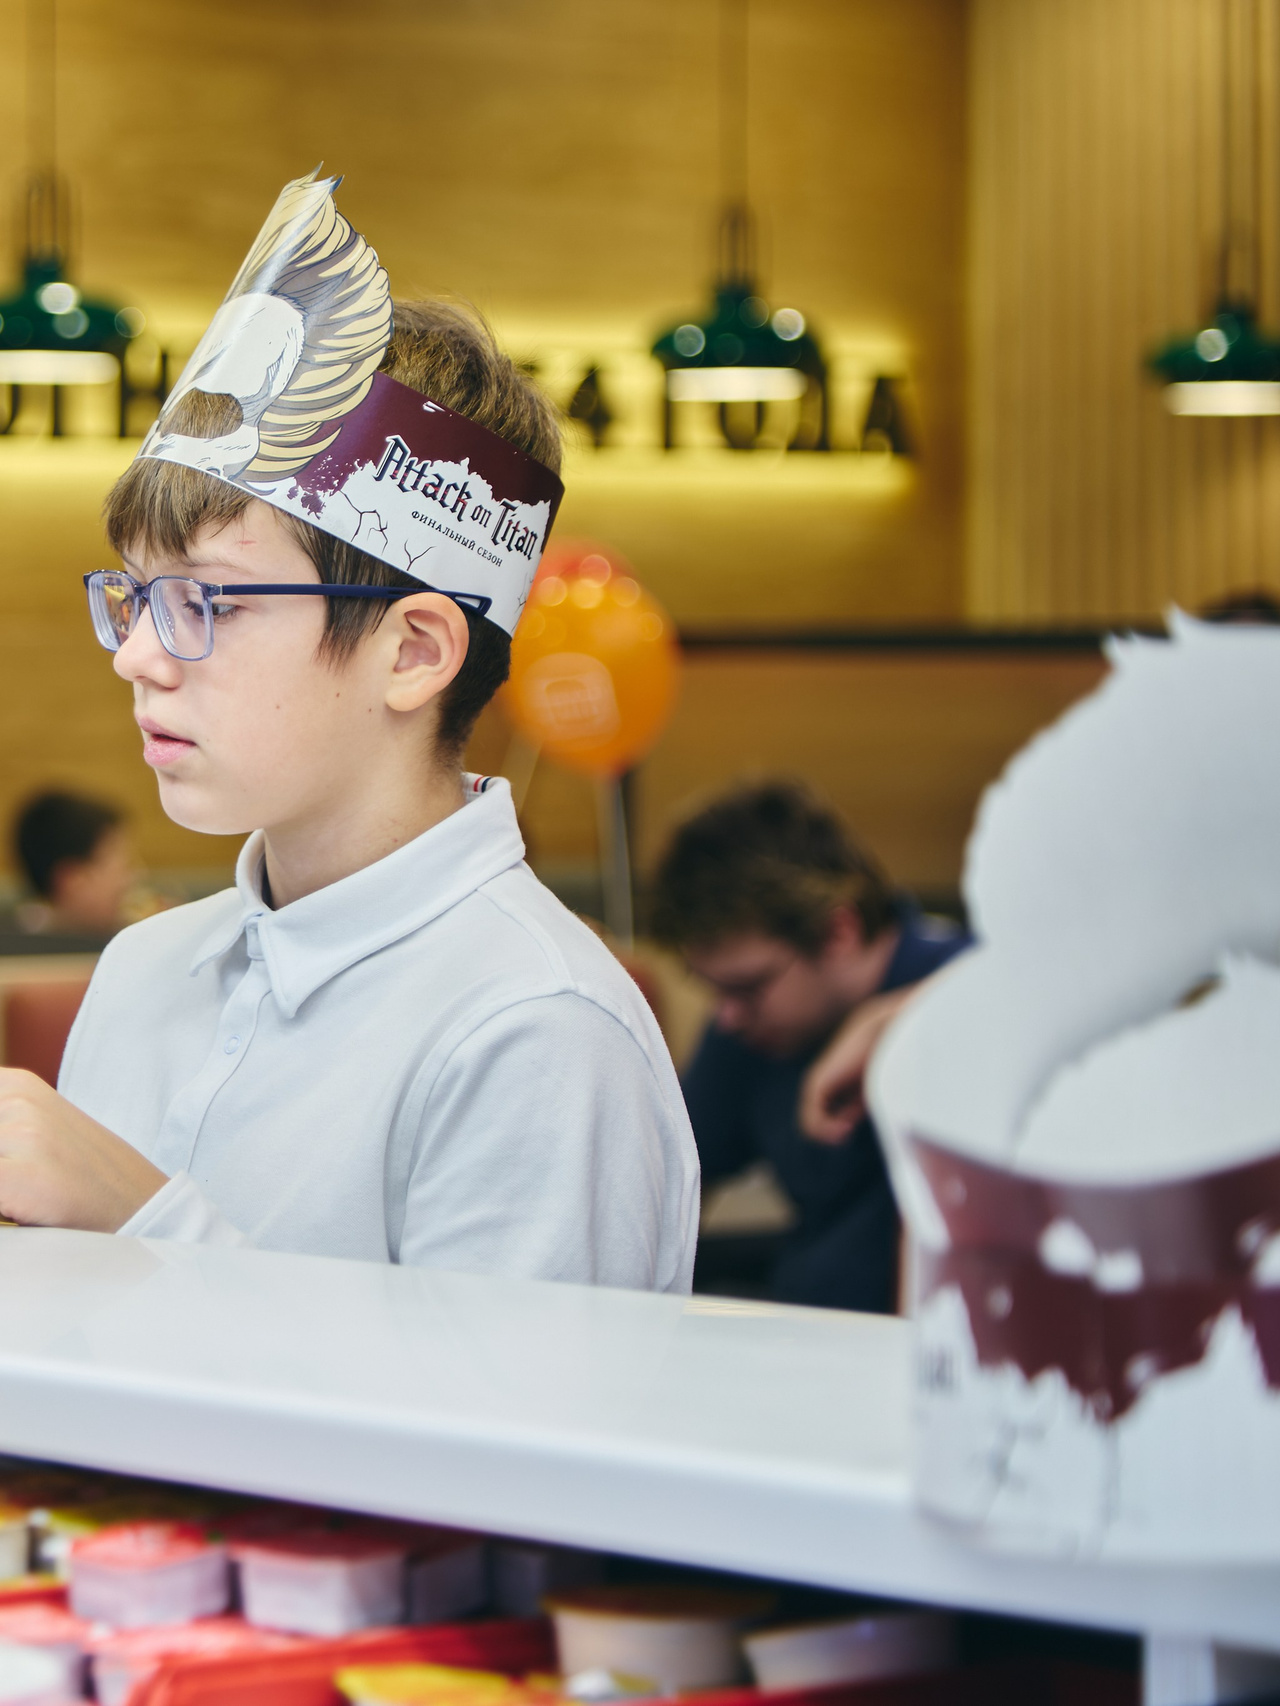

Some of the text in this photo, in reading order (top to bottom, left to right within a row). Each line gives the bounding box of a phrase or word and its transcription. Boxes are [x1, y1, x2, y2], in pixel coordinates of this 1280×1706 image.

[373, 435, 539, 561] Attack on Titan
[411, 510, 503, 568] ФИНАЛЬНЫЙ СЕЗОН
